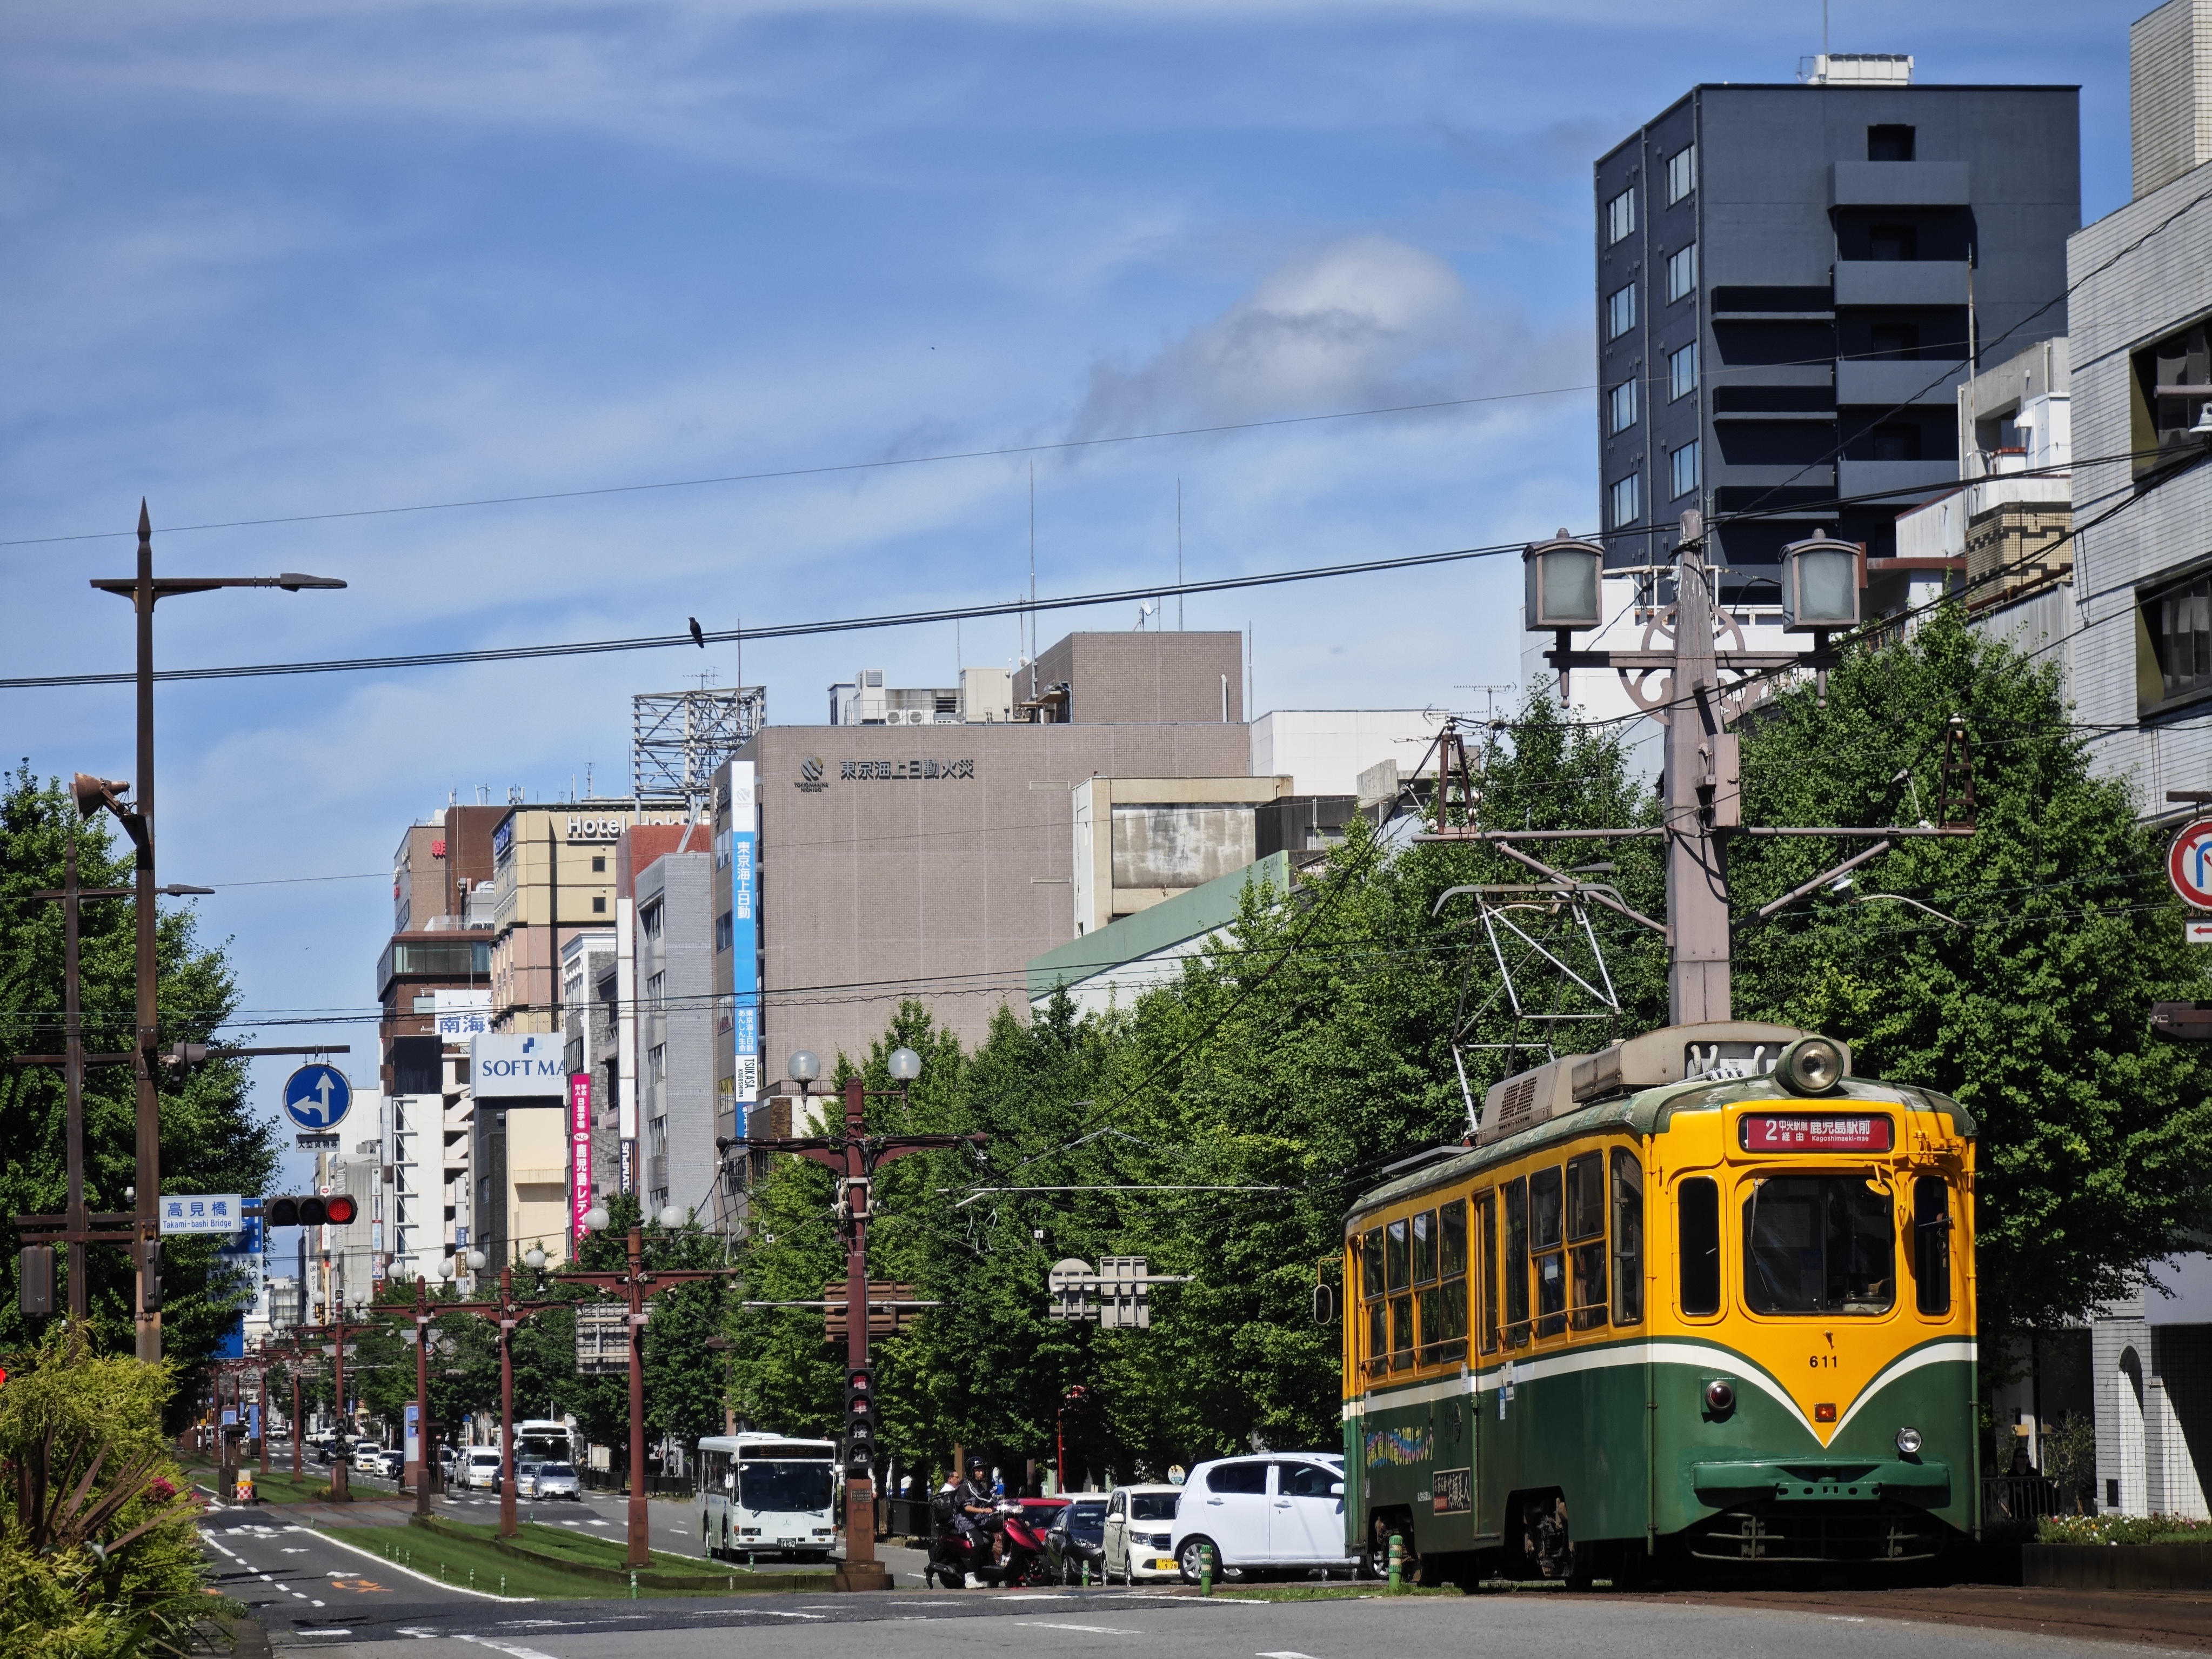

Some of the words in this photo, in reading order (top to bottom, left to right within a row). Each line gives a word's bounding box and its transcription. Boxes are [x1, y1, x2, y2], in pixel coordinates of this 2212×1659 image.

[840, 759, 974, 780] 東京海上日動火災
[567, 814, 626, 833] Hotel
[737, 841, 750, 919] 東京海上日動
[746, 1009, 754, 1052] 東京海上日動
[483, 1060, 533, 1076] SOFT
[744, 1058, 755, 1089] TSUKASA
[1765, 1120, 1777, 1141] 2
[1779, 1119, 1808, 1131] 中央駅前
[1810, 1119, 1870, 1135] 鹿児島駅前
[298, 1140, 338, 1149] 大型貨物等
[1782, 1132, 1805, 1141] 経由
[168, 1201, 228, 1218] 高見橋
[163, 1219, 209, 1229] Takami-bashi
[211, 1219, 232, 1228] Bridge
[1809, 1355, 1837, 1368] 611
[853, 1375, 867, 1463] 電車接近
